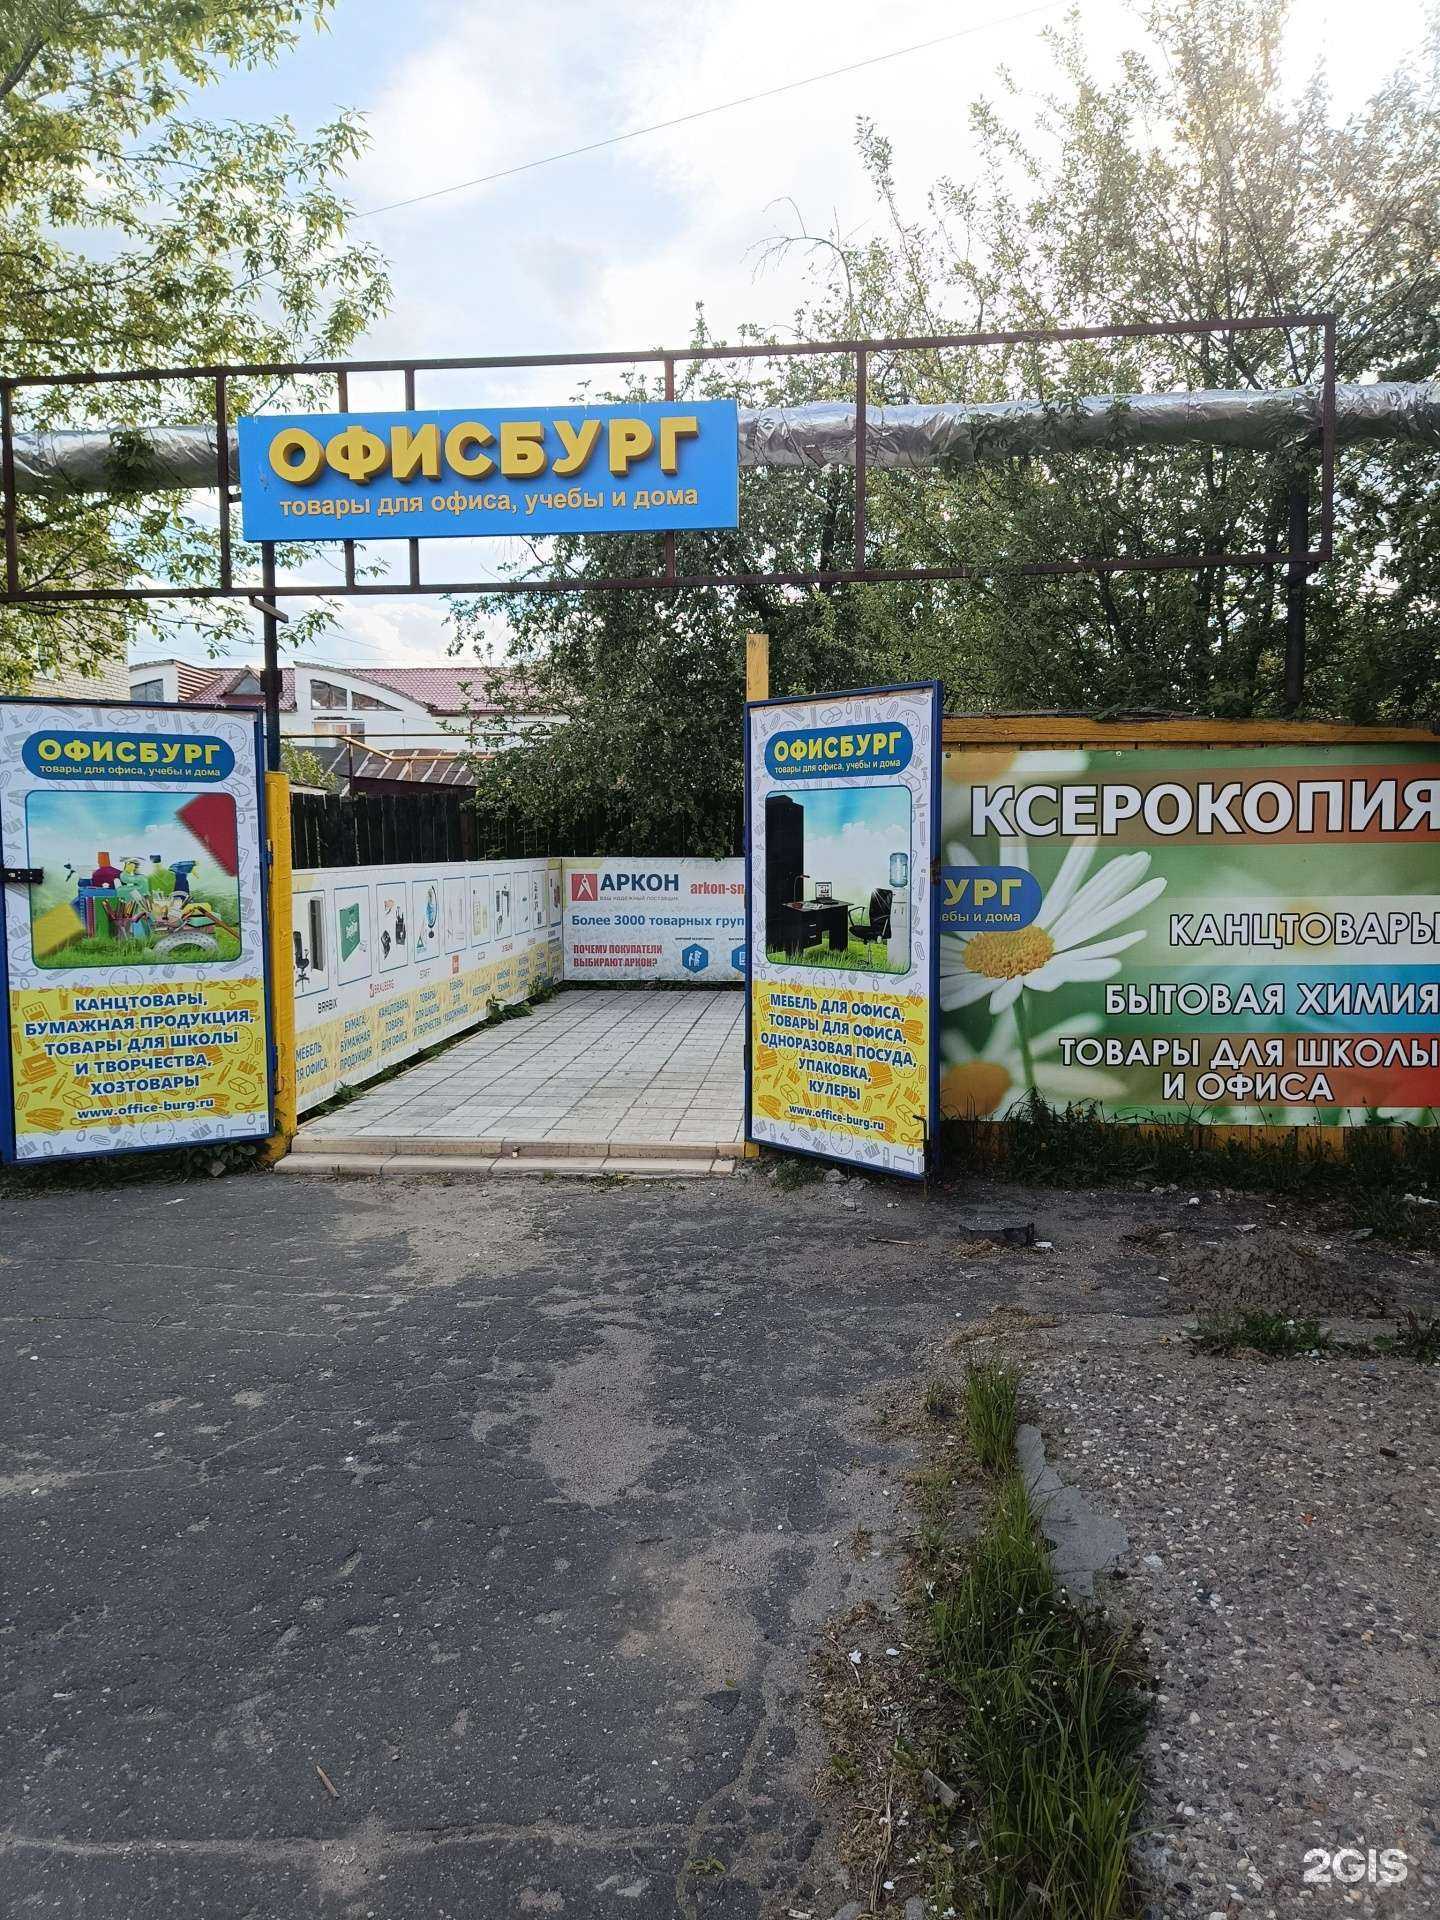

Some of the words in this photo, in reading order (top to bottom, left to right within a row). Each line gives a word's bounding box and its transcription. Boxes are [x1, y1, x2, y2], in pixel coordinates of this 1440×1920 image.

[268, 416, 701, 486] ОФИСБУРГ
[280, 495, 371, 519] товары
[377, 494, 421, 517] для
[431, 490, 518, 516] офиса,
[524, 487, 603, 514] учебы
[611, 491, 626, 508] и
[634, 488, 698, 510] дома
[37, 739, 221, 765] ОФИСБУРГ
[774, 732, 902, 761] ОФИСБУРГ
[40, 765, 82, 776] товары
[85, 766, 106, 776] для
[108, 765, 146, 777] офиса,
[149, 766, 183, 778] учебы
[194, 769, 221, 778] дома
[774, 766, 801, 775] товары
[802, 765, 817, 773] для
[818, 762, 845, 773] офиса,
[846, 760, 870, 771] учебы
[879, 759, 901, 769] дома
[971, 778, 1440, 837] КСЕРОКОПИЯ
[600, 873, 680, 892] АРКОН
[572, 915, 611, 926] Более
[614, 915, 646, 926] 3000
[649, 916, 712, 928] товарных
[973, 913, 982, 922] и
[986, 913, 1021, 923] дома
[1169, 911, 1440, 950] КАНЦТОВАРЫ
[573, 944, 607, 954] ПОЧЕМУ
[609, 944, 662, 954] ПОКУПАТЕЛИ
[573, 957, 622, 968] ВЫБИРАЮТ
[623, 957, 658, 968] АРКОН?
[75, 993, 208, 1012] КАНЦТОВАРЫ,
[770, 993, 817, 1010] МЕБЕЛЬ
[820, 1000, 848, 1015] ДЛЯ
[851, 1002, 904, 1022] ОФИСА,
[1105, 984, 1286, 1015] БЫТОВАЯ
[1297, 983, 1440, 1015] ХИМИЯ
[25, 1018, 134, 1036] БУМАЖНАЯ
[140, 1009, 254, 1030] ПРОДУКЦИЯ,
[769, 1013, 819, 1031] ТОВАРЫ
[822, 1020, 850, 1036] ДЛЯ
[853, 1024, 906, 1044] ОФИСА,
[44, 1039, 122, 1056] ТОВАРЫ
[127, 1036, 165, 1052] ДЛЯ
[170, 1031, 238, 1046] ШКОЛЫ
[295, 1042, 322, 1062] МЕБЕЛЬ
[761, 1032, 852, 1056] ОДНОРАЗОВАЯ
[856, 1045, 916, 1068] ПОСУДА,
[1059, 1037, 1200, 1068] ТОВАРЫ
[1209, 1038, 1283, 1070] ДЛЯ
[1296, 1037, 1440, 1068] ШКОЛЫ
[75, 1063, 89, 1075] И
[95, 1054, 212, 1074] ТВОРЧЕСТВА,
[798, 1058, 871, 1082] УПАКОВКА,
[90, 1074, 200, 1095] ХОЗТОВАРЫ
[809, 1079, 861, 1100] КУЛЕРЫ
[1163, 1073, 1186, 1101] И
[1196, 1071, 1335, 1103] ОФИСА
[78, 1098, 215, 1120] www.office-burg.ru
[789, 1104, 884, 1131] www.office-burg.ru
